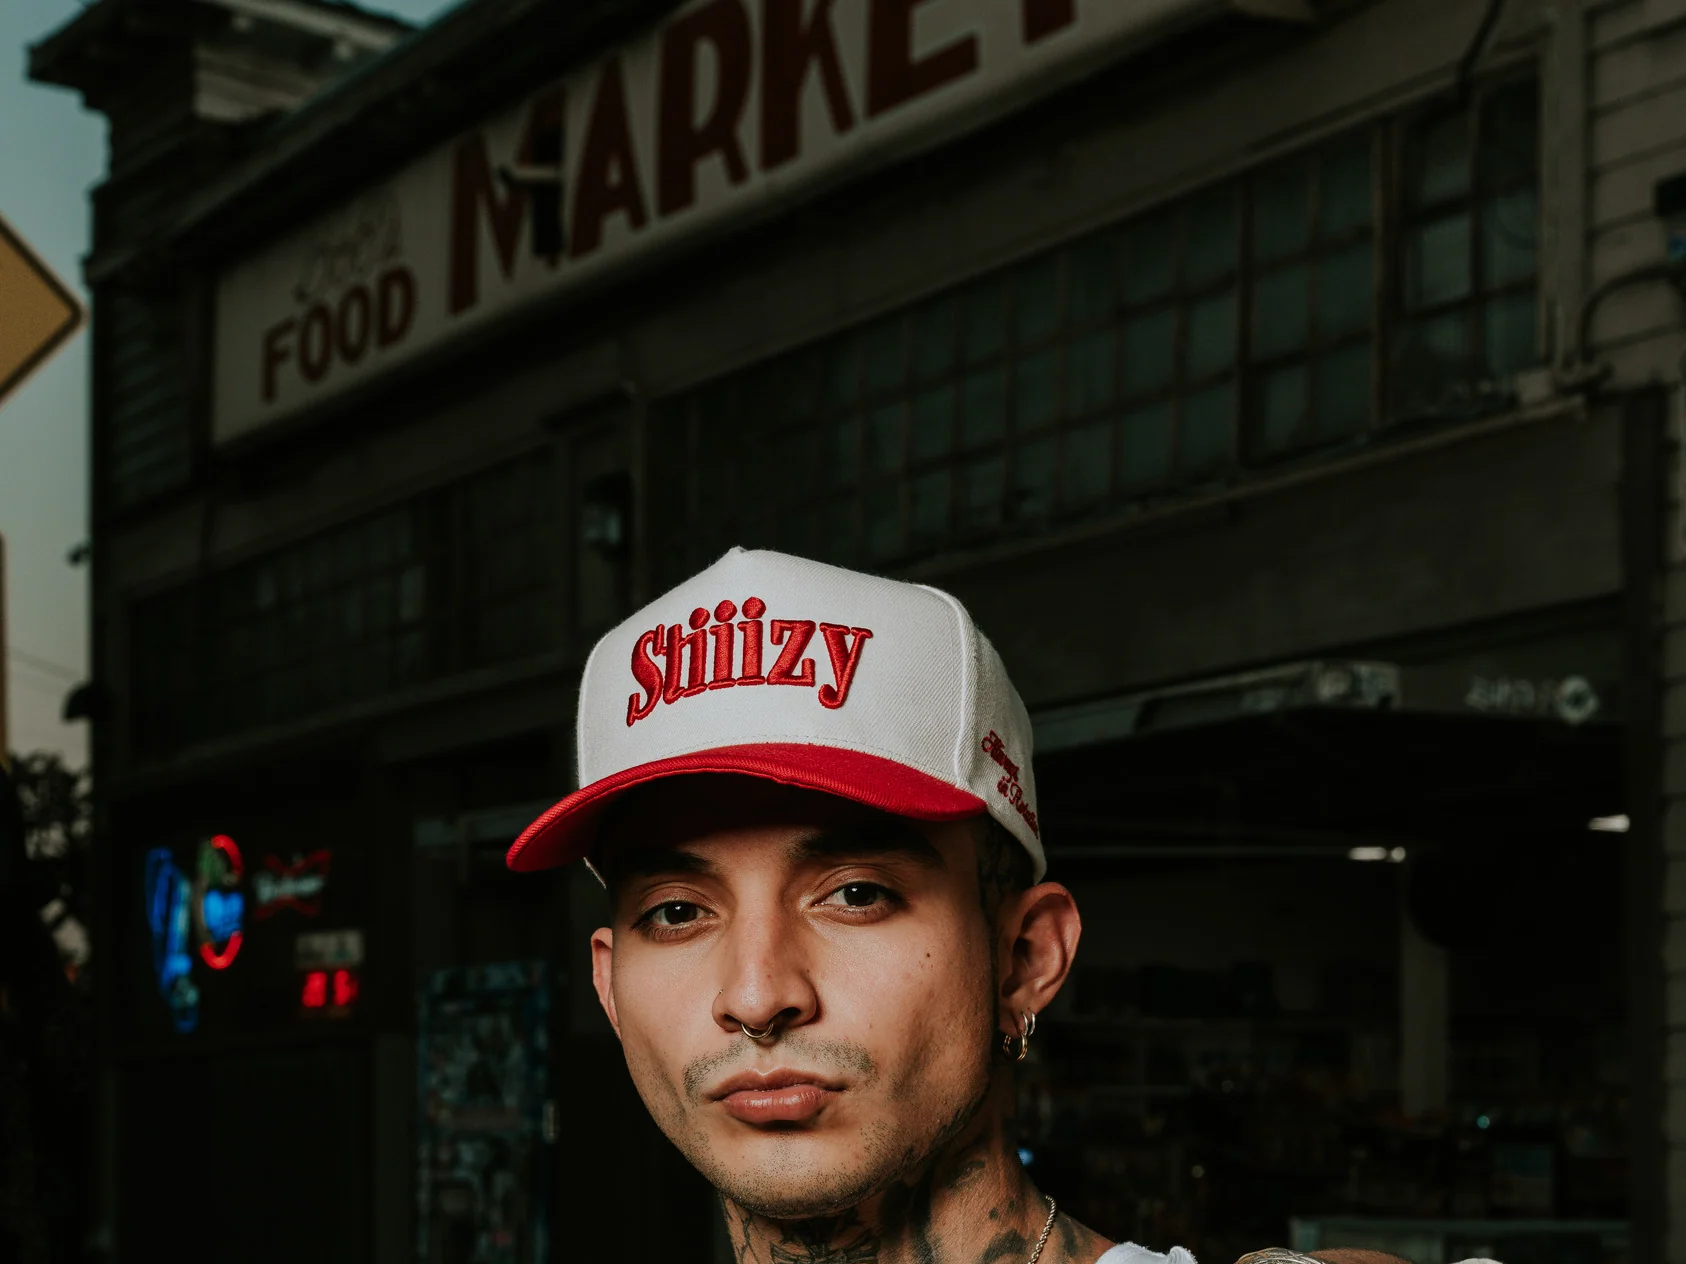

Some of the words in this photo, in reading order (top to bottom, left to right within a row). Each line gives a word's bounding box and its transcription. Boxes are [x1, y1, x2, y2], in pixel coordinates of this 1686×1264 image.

[262, 268, 415, 404] FOOD
[446, 0, 1076, 318] MARKE
[626, 597, 873, 727] Stiiizy
